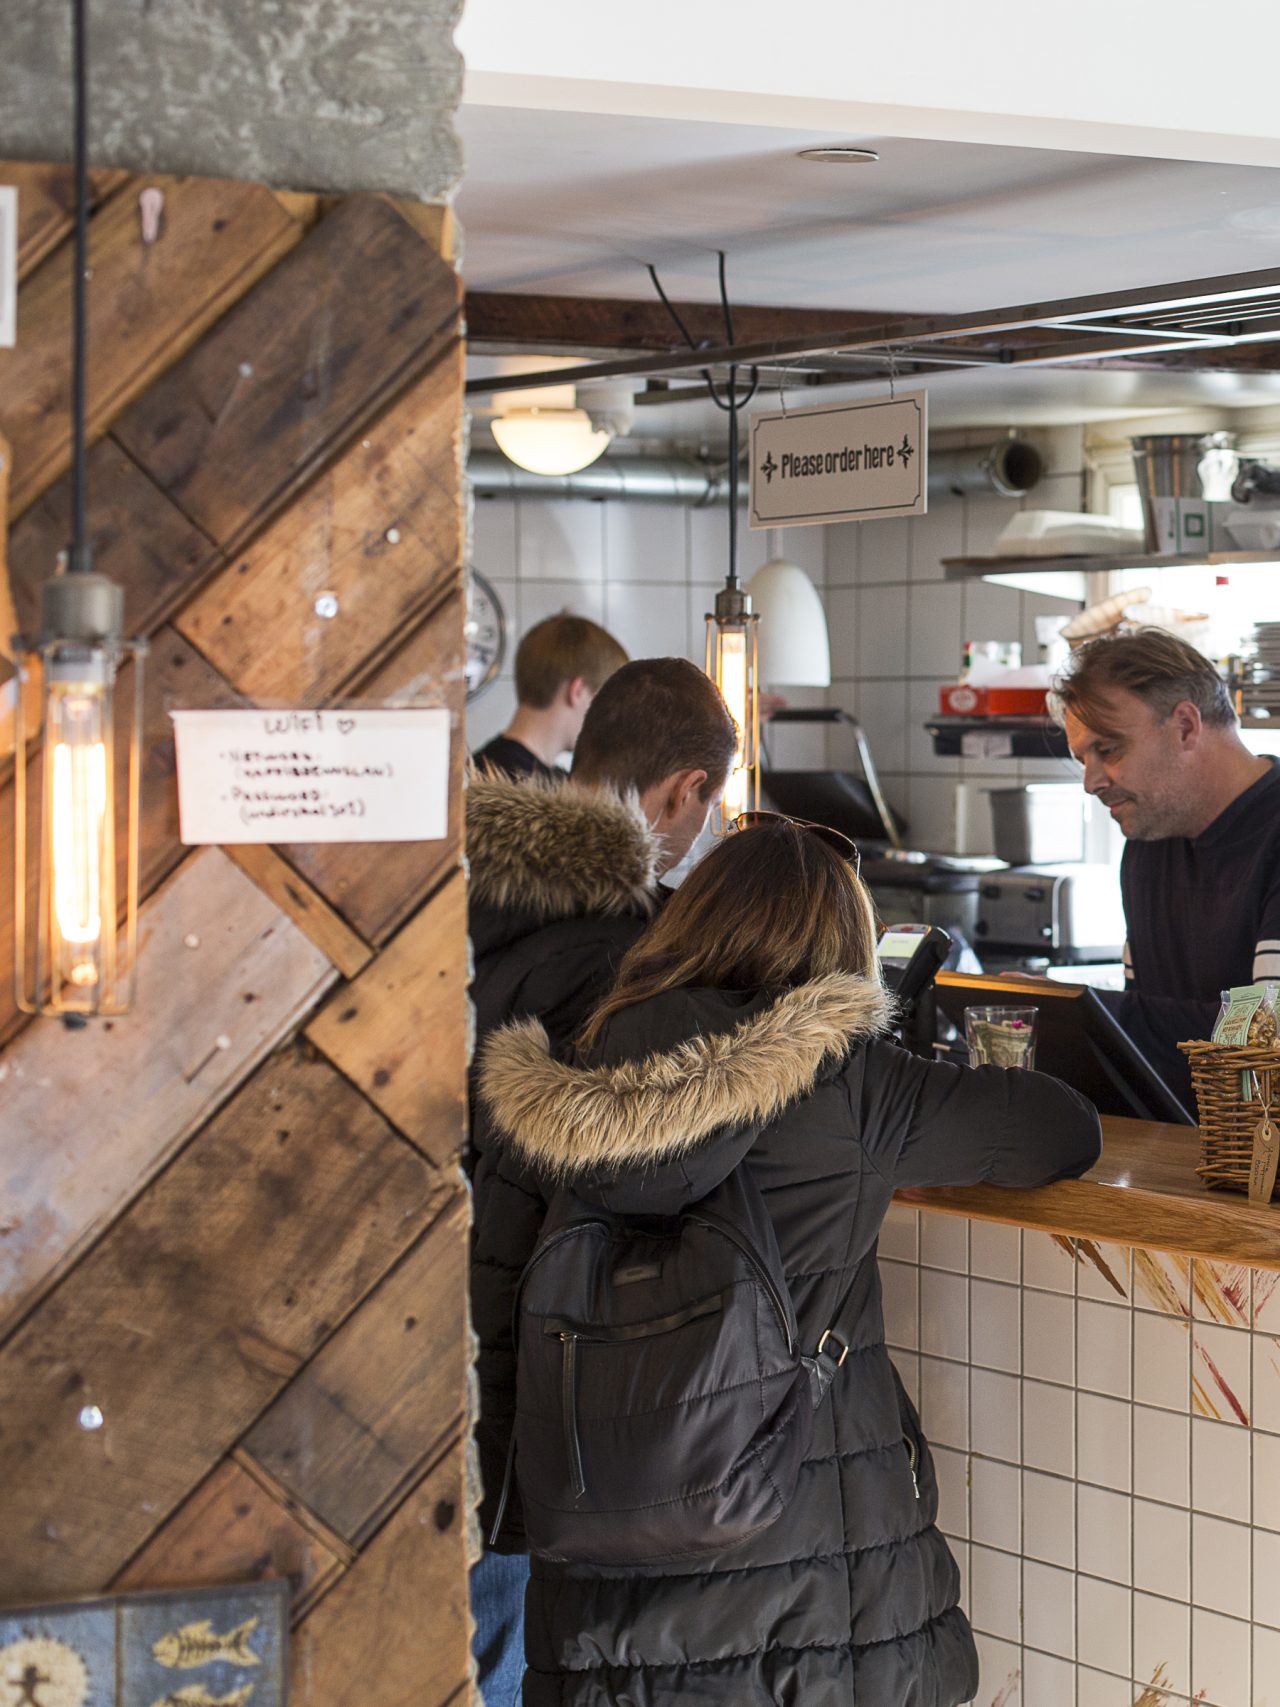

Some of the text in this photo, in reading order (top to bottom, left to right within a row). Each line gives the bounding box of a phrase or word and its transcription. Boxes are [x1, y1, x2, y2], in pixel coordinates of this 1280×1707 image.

[781, 444, 895, 479] Please order here
